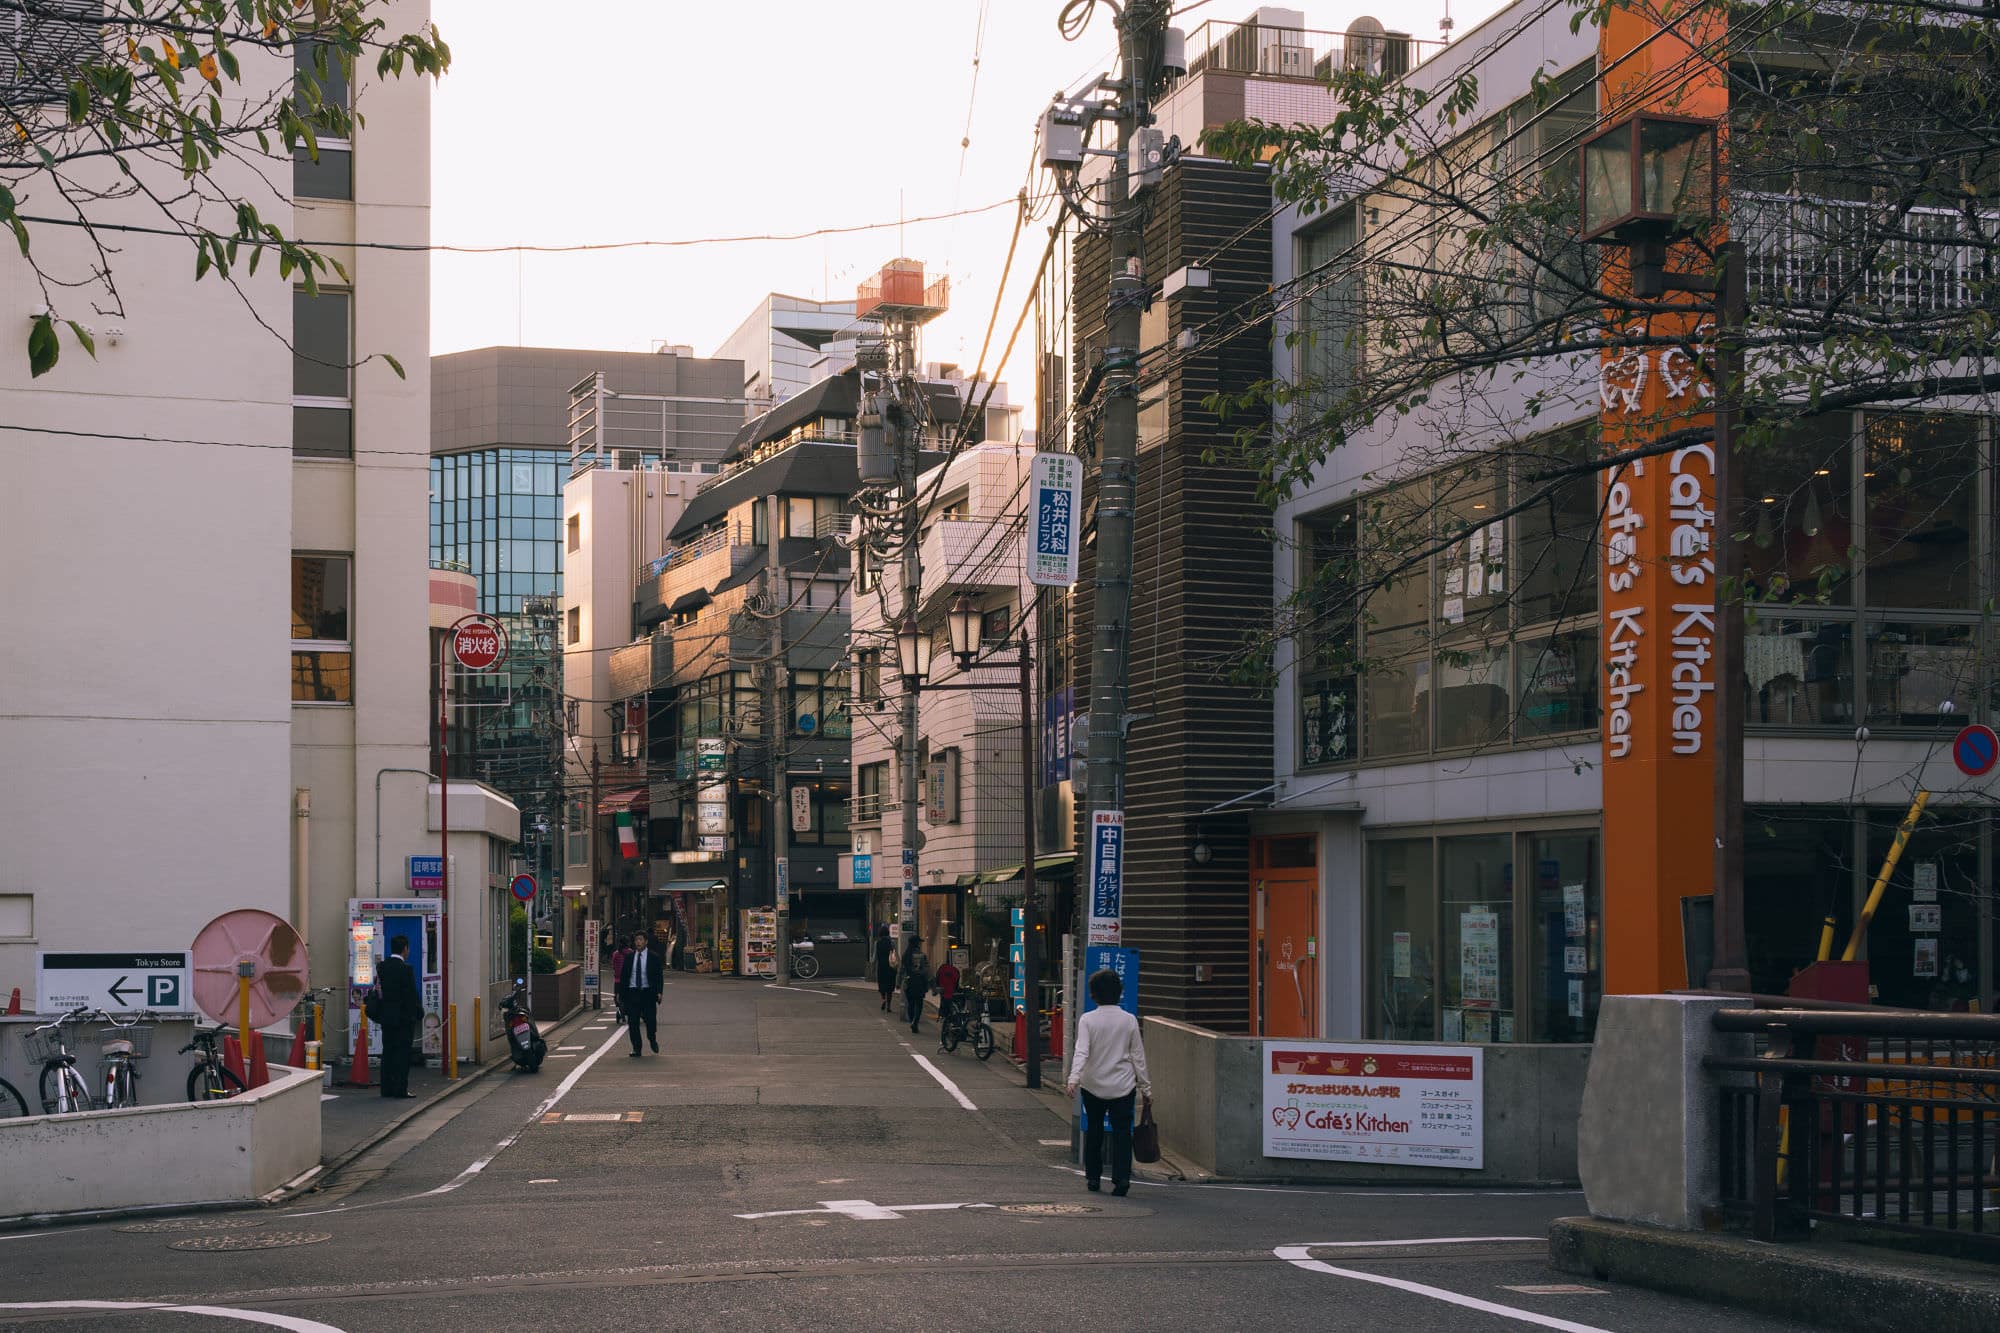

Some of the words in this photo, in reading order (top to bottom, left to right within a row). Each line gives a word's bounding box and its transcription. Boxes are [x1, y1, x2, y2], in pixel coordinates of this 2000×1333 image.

[1039, 503, 1051, 551] クリニック
[1051, 491, 1069, 553] 松井内科
[458, 637, 496, 655] 消火栓
[1609, 606, 1645, 758] Kitchen
[1671, 603, 1715, 755] Kitchen
[1101, 827, 1117, 875] 中目黒
[136, 958, 159, 967] Tokyu
[160, 958, 181, 967] Store
[155, 978, 175, 1003] P
[1286, 1082, 1401, 1098] カフェをはじめる人の学校
[1356, 1112, 1409, 1134] Kitchen
